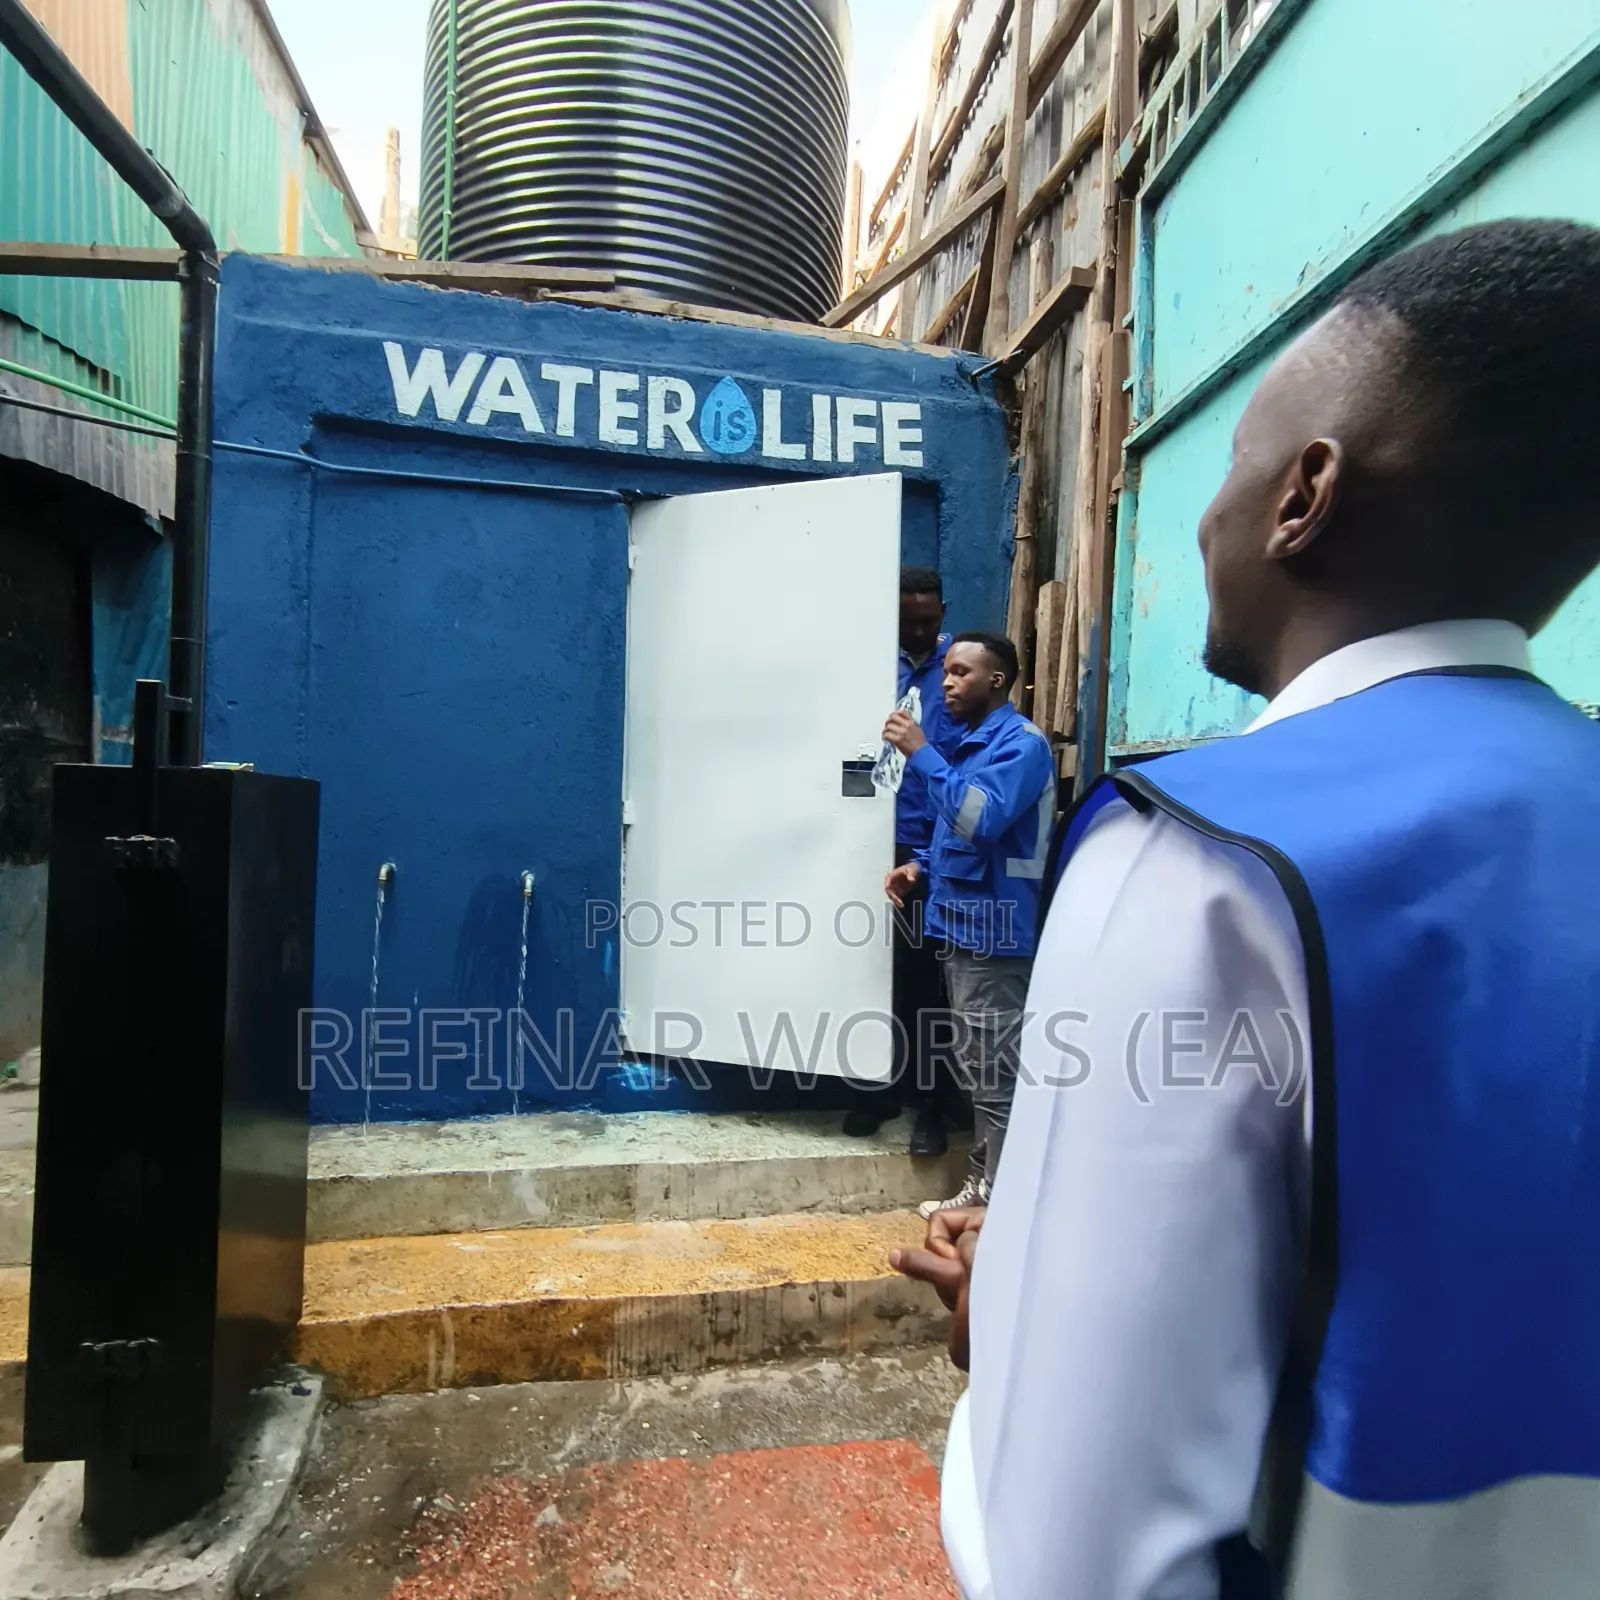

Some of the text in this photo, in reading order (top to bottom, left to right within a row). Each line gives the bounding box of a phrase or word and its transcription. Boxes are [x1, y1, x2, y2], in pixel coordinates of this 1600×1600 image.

[382, 341, 924, 468] WATER is LIFE
